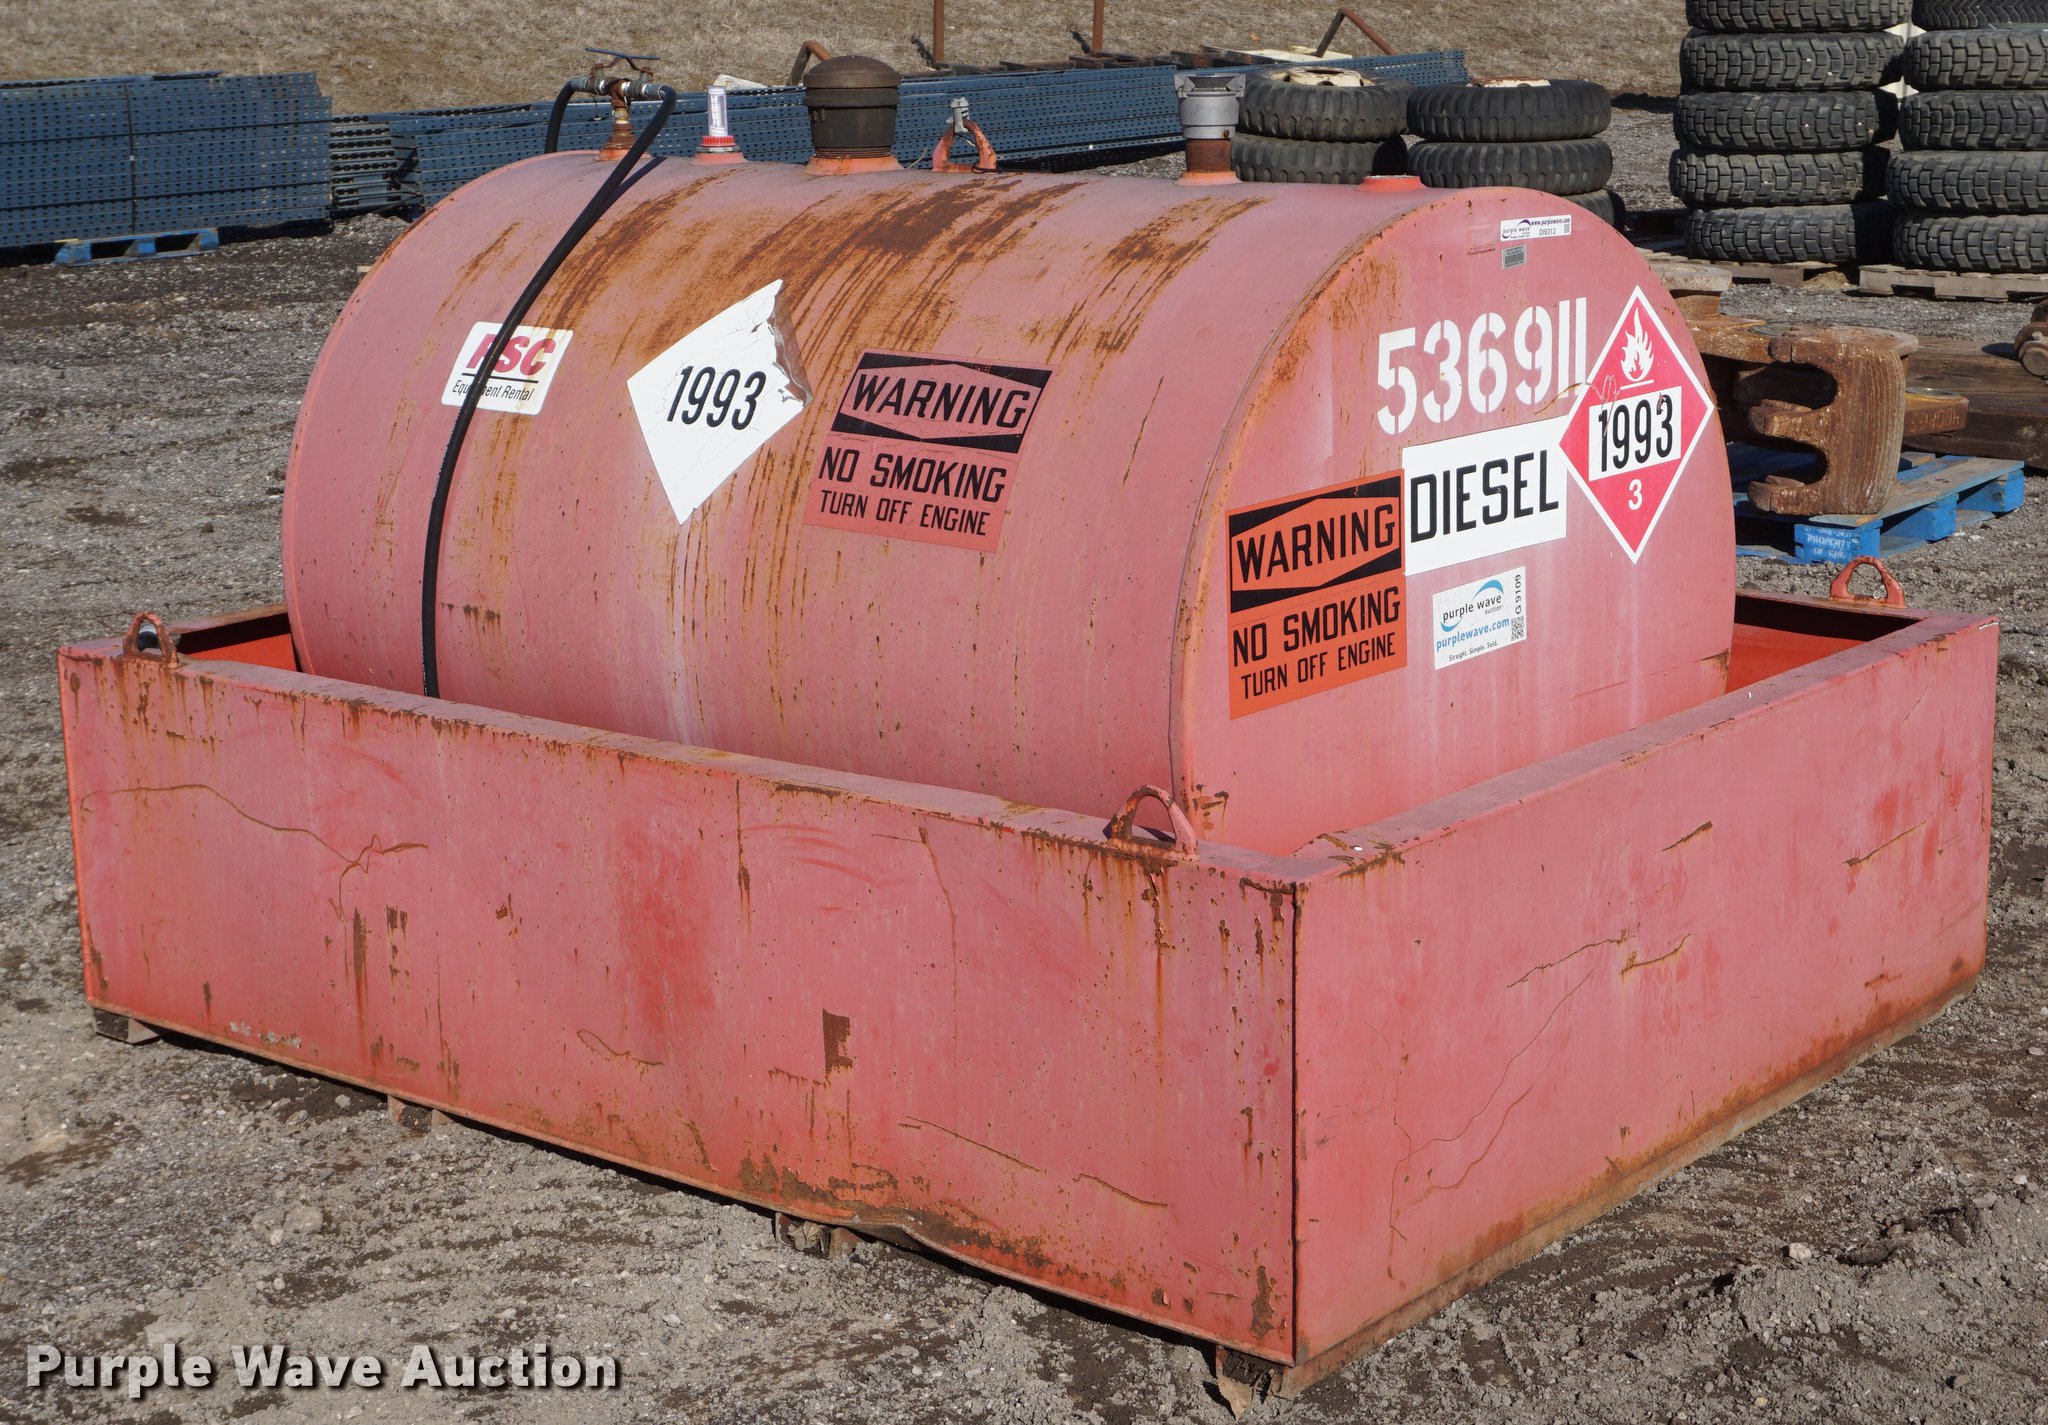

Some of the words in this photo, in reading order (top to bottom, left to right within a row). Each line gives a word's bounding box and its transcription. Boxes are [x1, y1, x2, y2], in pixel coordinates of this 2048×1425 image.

[501, 385, 535, 401] Rental
[667, 365, 767, 431] 1993
[852, 373, 1031, 429] WARNING
[1598, 394, 1673, 473] 1993
[818, 446, 860, 483] NO
[870, 453, 1008, 503] SMOKING
[1410, 449, 1559, 544] DIESEL
[1628, 478, 1643, 511] 3
[820, 490, 869, 519] TURN
[876, 497, 913, 524] OFF
[920, 503, 990, 536] ENGINE
[1236, 503, 1396, 584] WARNING
[1443, 603, 1474, 623] purple
[1477, 595, 1502, 610] wave
[1514, 574, 1522, 603] 9109
[1515, 605, 1522, 615] G
[1233, 622, 1267, 667] NO
[1283, 586, 1400, 652] SMOKING
[1436, 618, 1510, 652] purplewave.com
[1241, 662, 1288, 700] TURN
[1298, 651, 1328, 684] OFF
[1338, 632, 1396, 672] ENGINE
